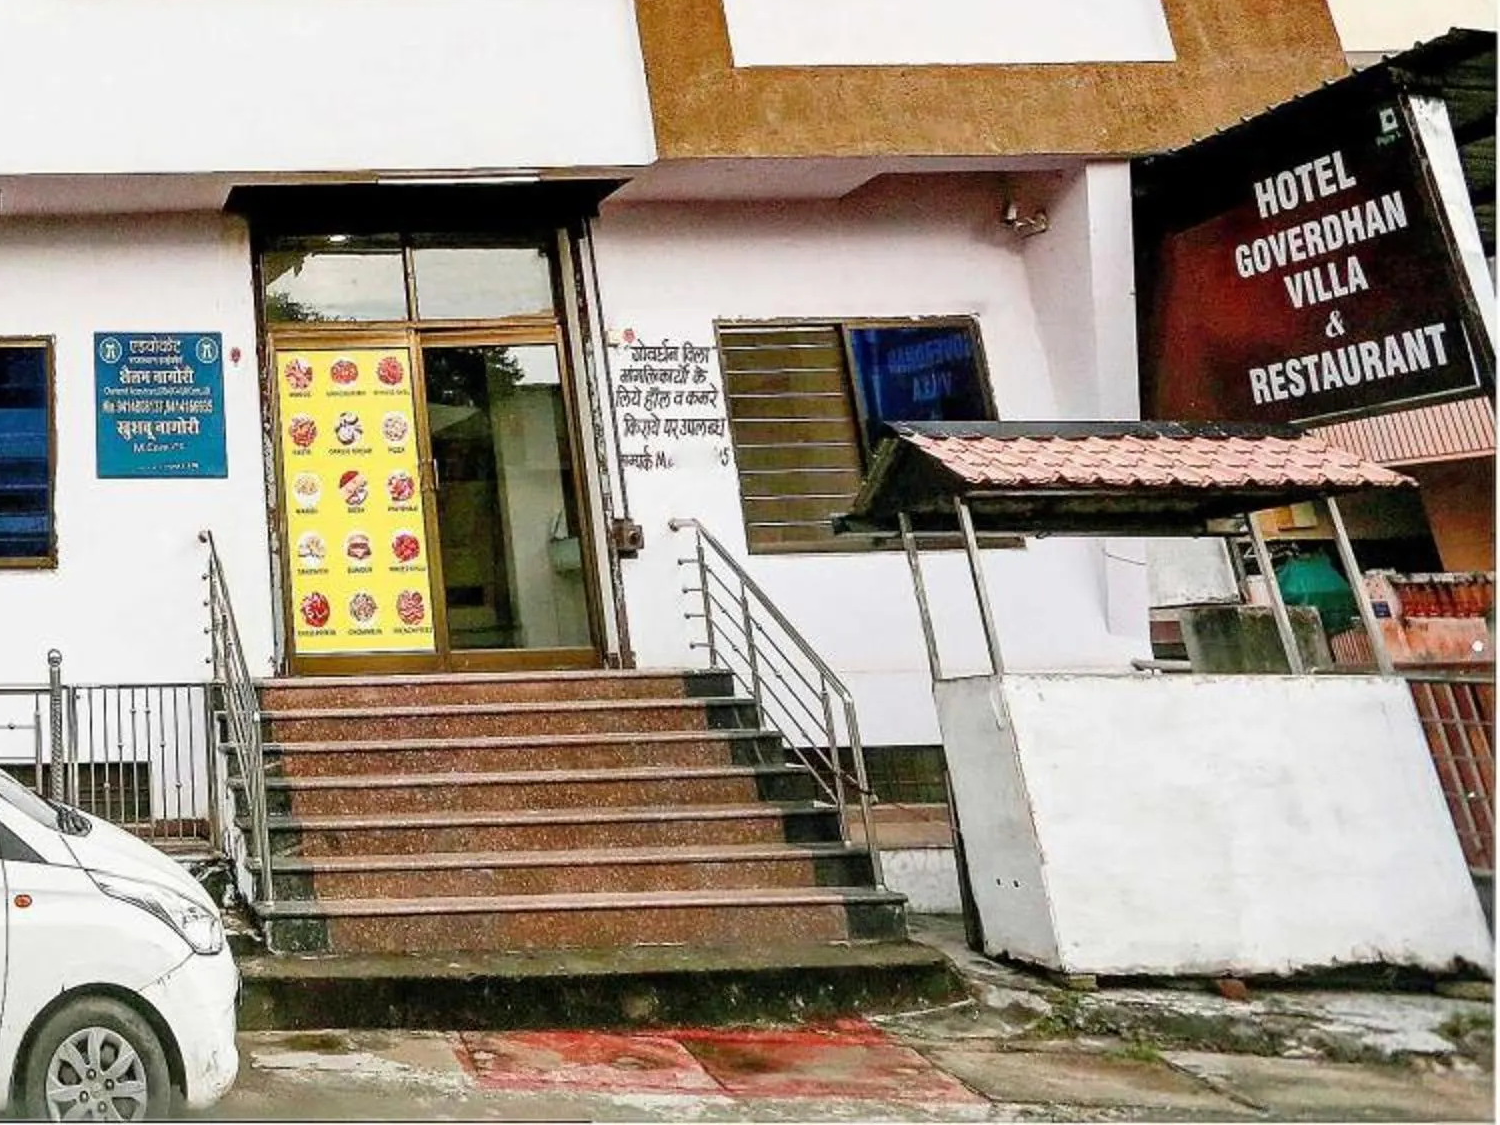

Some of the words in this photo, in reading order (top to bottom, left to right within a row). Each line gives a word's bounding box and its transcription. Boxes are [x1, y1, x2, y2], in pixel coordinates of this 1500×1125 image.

[1254, 151, 1356, 219] HOTEL
[1235, 191, 1407, 277] GOVERDHAN
[1284, 256, 1369, 308] VILLA
[1325, 310, 1345, 337] &
[1249, 323, 1448, 405] RESTAURANT
